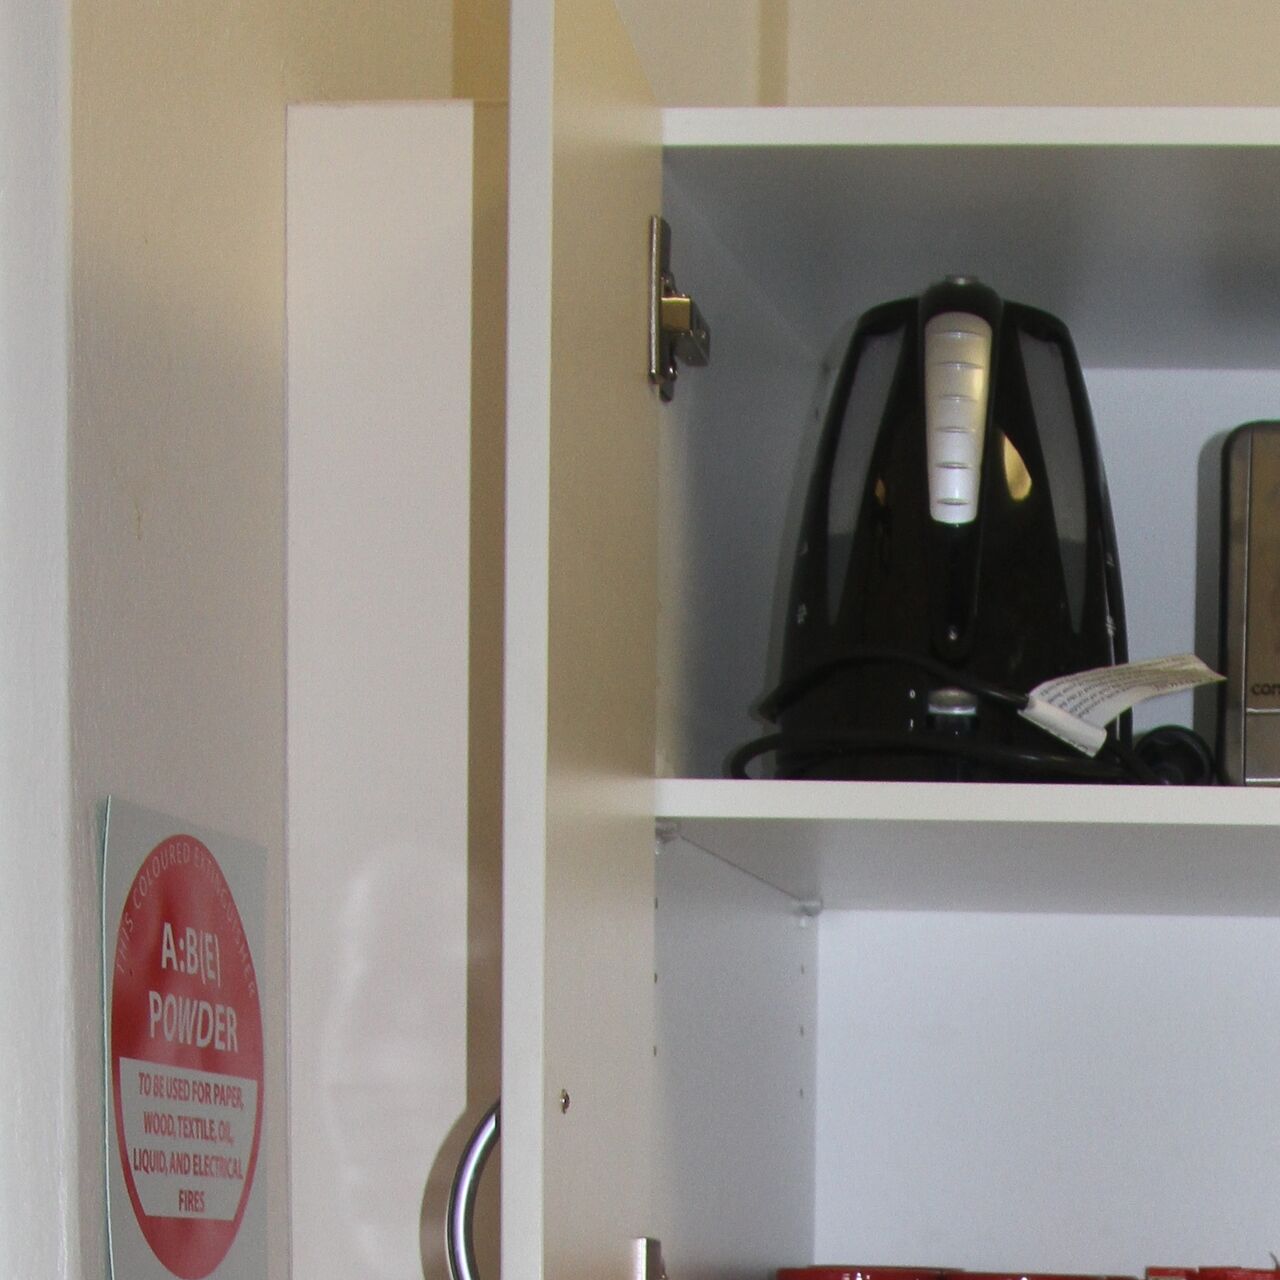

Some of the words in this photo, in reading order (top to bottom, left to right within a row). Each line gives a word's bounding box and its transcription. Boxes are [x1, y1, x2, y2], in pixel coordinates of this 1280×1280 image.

[115, 912, 134, 974] THIS
[132, 842, 190, 909] COLOURED
[148, 990, 239, 1053] POWDER
[138, 1072, 151, 1095] TO
[153, 1075, 164, 1098] BE
[166, 1076, 189, 1101] USED
[192, 1081, 212, 1105] FOR
[133, 1148, 168, 1176] LIQUID,
[170, 1151, 191, 1175] AND
[192, 1153, 244, 1179] ELECTRICAL
[178, 1189, 206, 1212] FIRES
